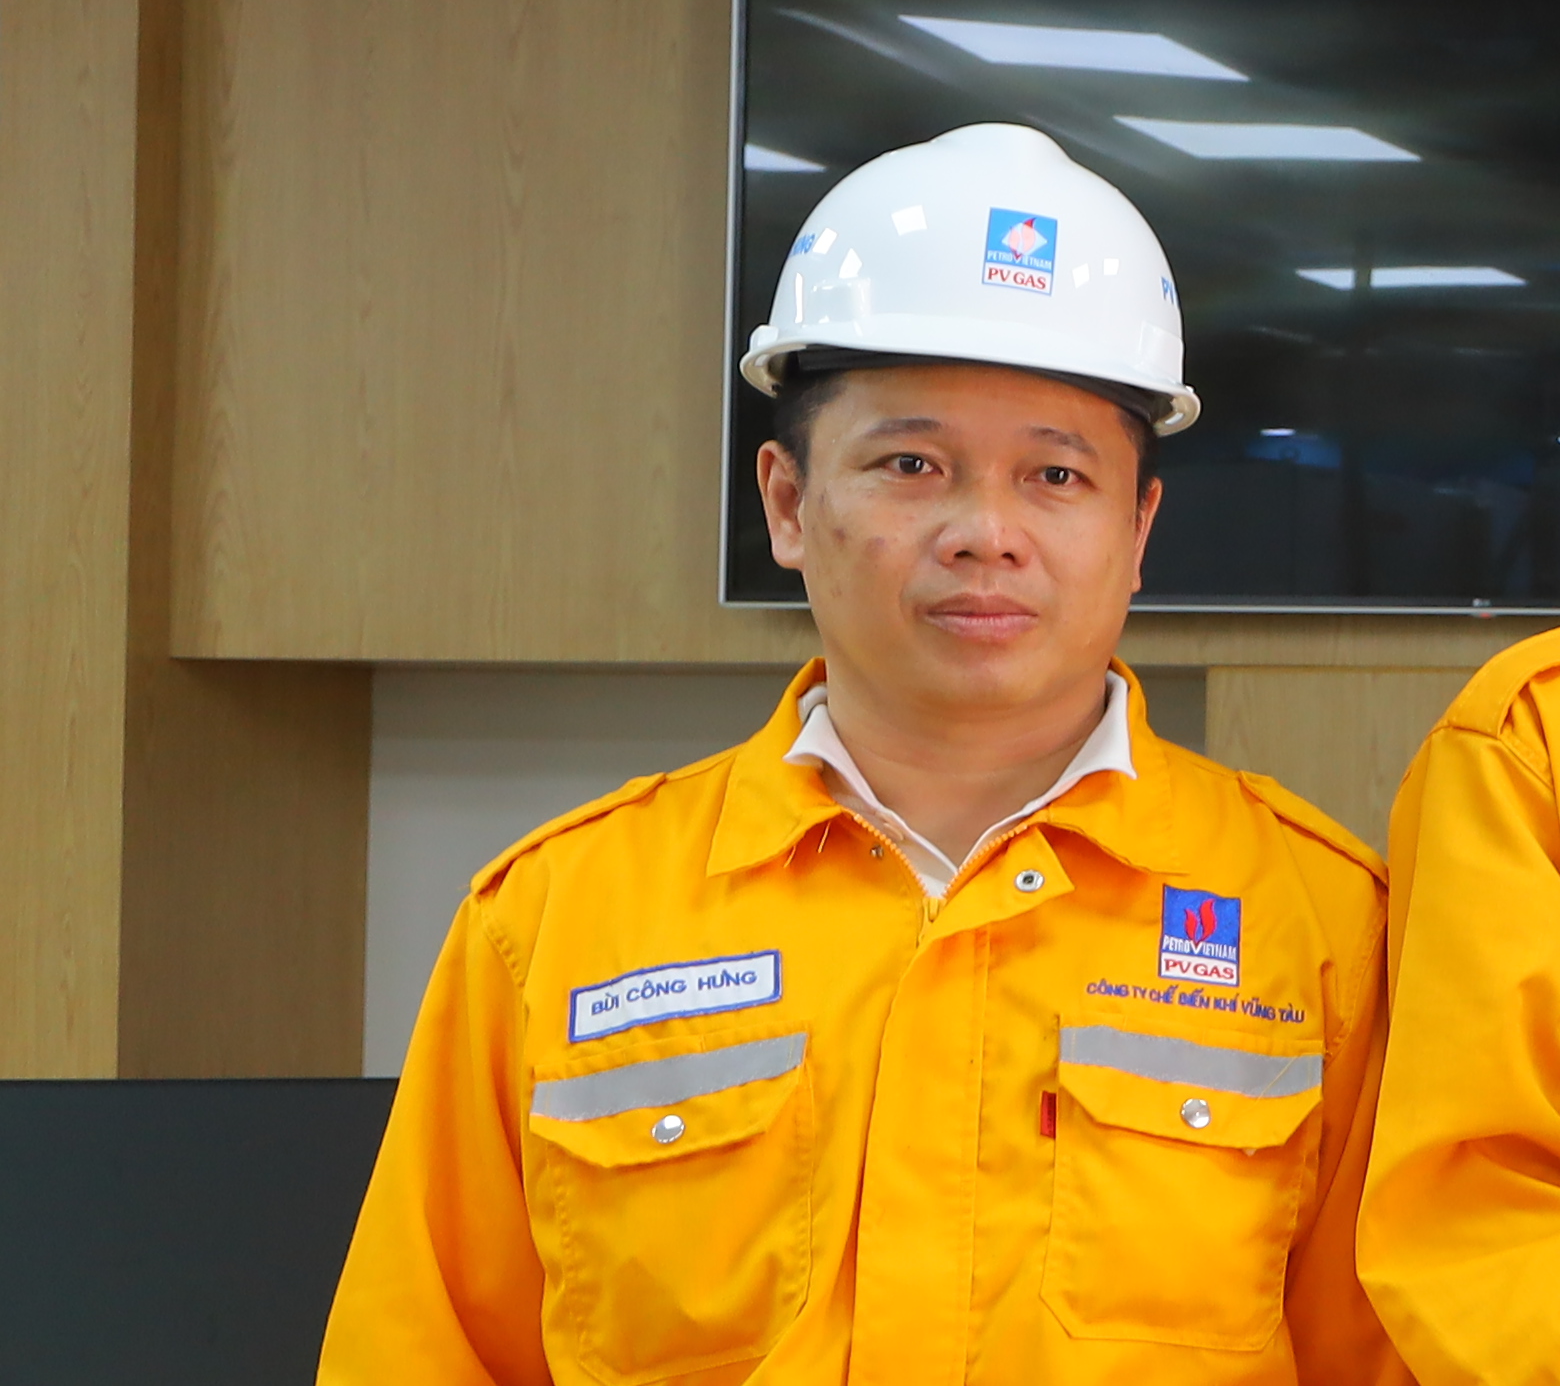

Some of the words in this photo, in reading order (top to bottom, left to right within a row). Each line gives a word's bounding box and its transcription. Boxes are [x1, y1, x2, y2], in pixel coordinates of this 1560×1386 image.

[987, 251, 1052, 270] PETROVIETNAM
[987, 267, 1010, 283] PV
[1013, 271, 1047, 291] GAS
[1162, 935, 1237, 961] PETROVIETNAM
[1163, 958, 1192, 974] PV
[1194, 962, 1235, 981] GAS
[591, 992, 620, 1016] BÙI
[626, 979, 687, 1002] CÔNG
[1086, 978, 1129, 997] CÔNG
[1132, 986, 1147, 1000] TY
[1150, 984, 1179, 1004] CHẾ
[1178, 988, 1210, 1009] BIẾN
[1213, 993, 1239, 1013] KHÍ
[1241, 996, 1276, 1021] VŨNG
[1278, 1002, 1305, 1024] TÀU
